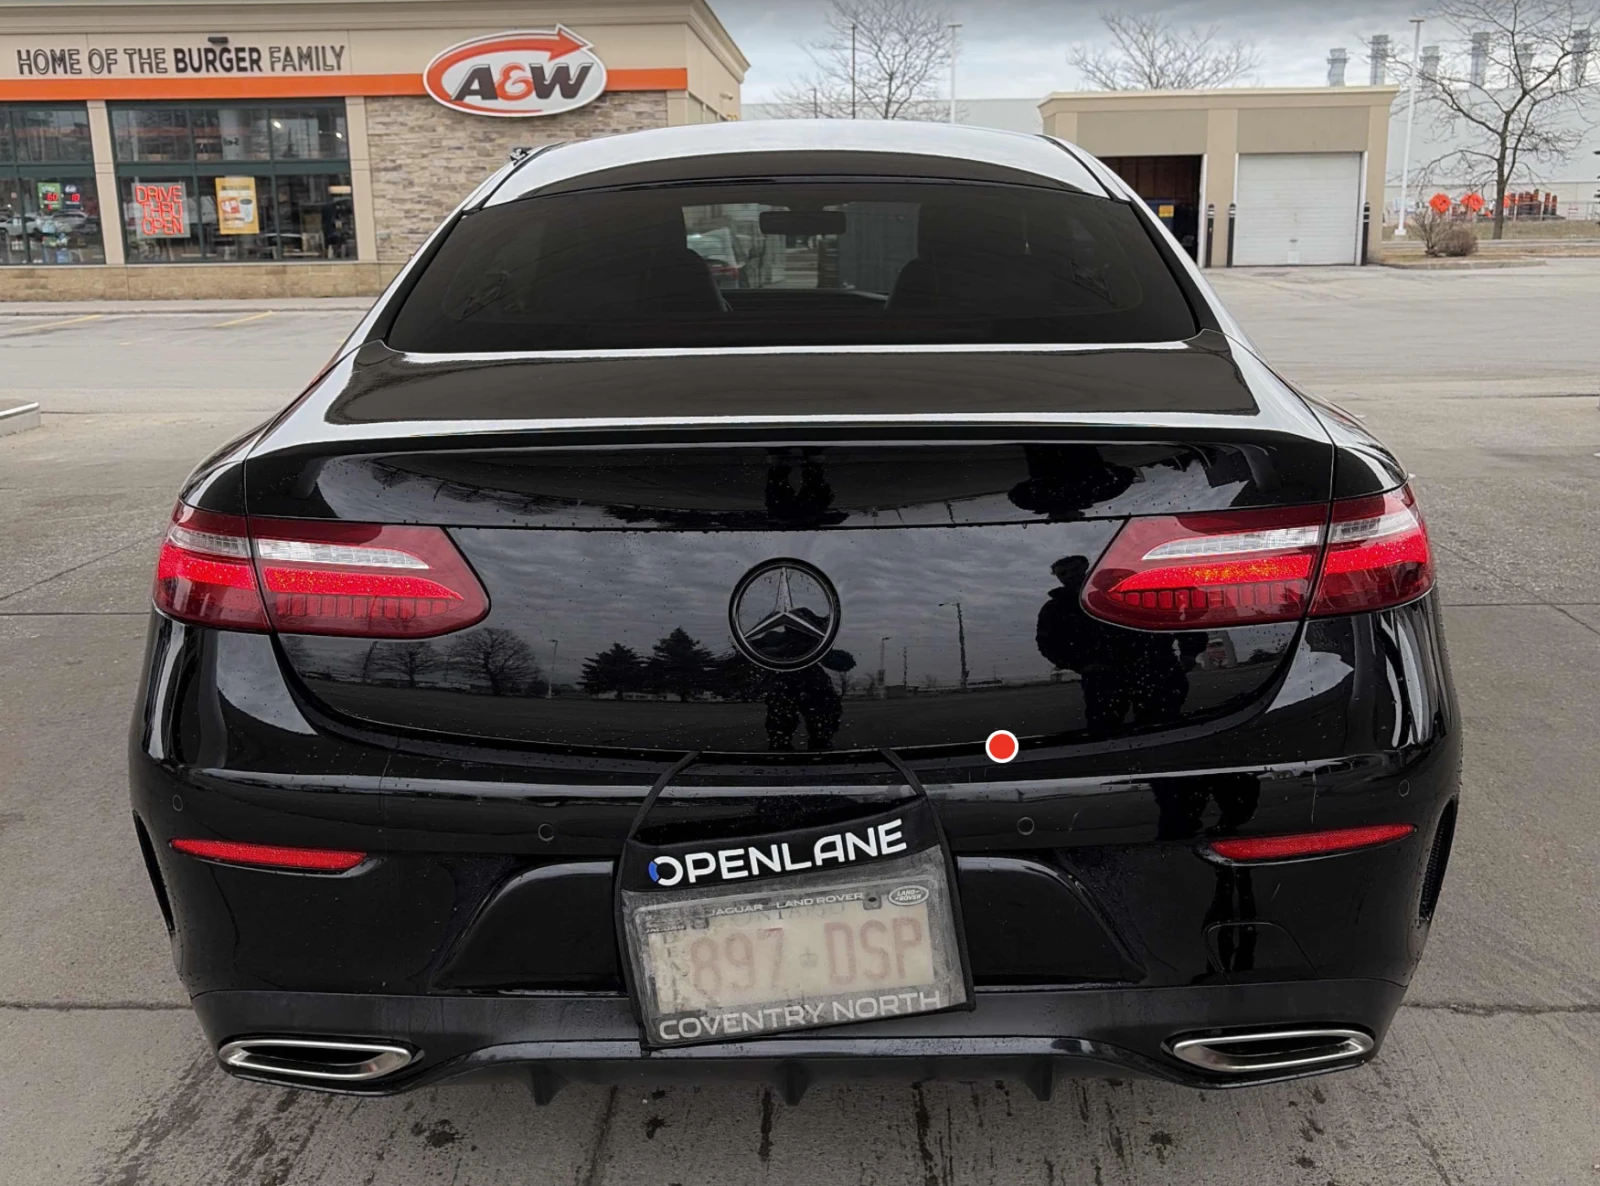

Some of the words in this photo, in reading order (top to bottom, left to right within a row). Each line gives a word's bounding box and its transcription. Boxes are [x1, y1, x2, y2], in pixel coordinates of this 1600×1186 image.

[17, 49, 82, 75] HOME
[88, 48, 118, 74] OF
[124, 48, 167, 74] THE
[173, 46, 262, 73] BURGER
[269, 45, 345, 72] FAMILY
[451, 62, 594, 101] A&W
[135, 185, 182, 204] DRIVE
[142, 201, 184, 219] THRU
[141, 217, 184, 236] OPEN
[649, 818, 907, 886] OPENLANE
[709, 903, 764, 917] JAGUAR
[776, 898, 813, 909] LAND
[816, 892, 864, 906] ROVER
[690, 927, 784, 998] 897
[823, 916, 923, 985] DSP
[659, 1001, 826, 1040] COVENTRY
[832, 990, 941, 1022] NORTH
